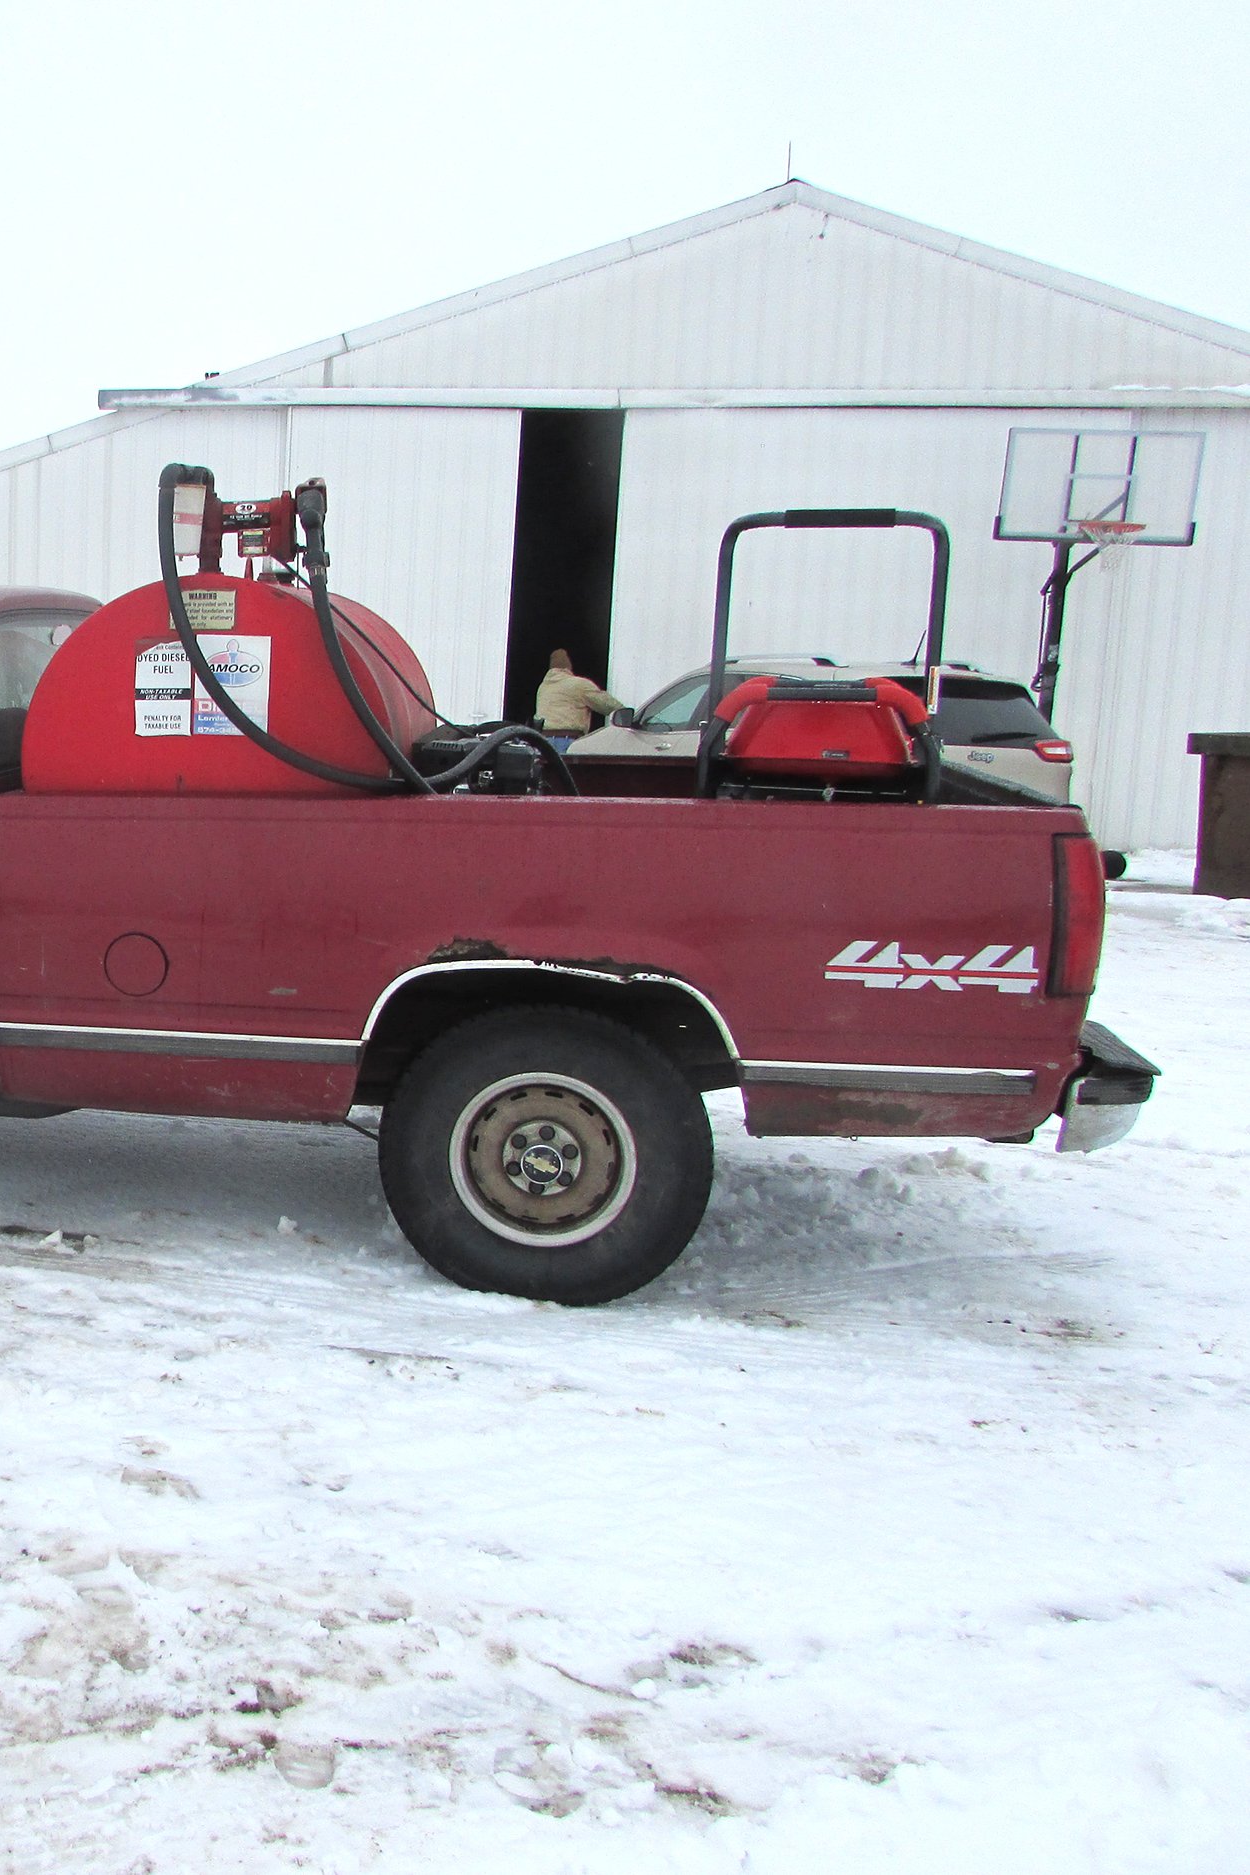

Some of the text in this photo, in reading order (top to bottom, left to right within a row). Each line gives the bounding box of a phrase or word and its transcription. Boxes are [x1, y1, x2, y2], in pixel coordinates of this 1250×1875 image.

[138, 653, 190, 663] DYED DIESEL
[153, 665, 174, 674] FUEL
[208, 664, 260, 674] AMOCO
[967, 750, 995, 764] Jeep
